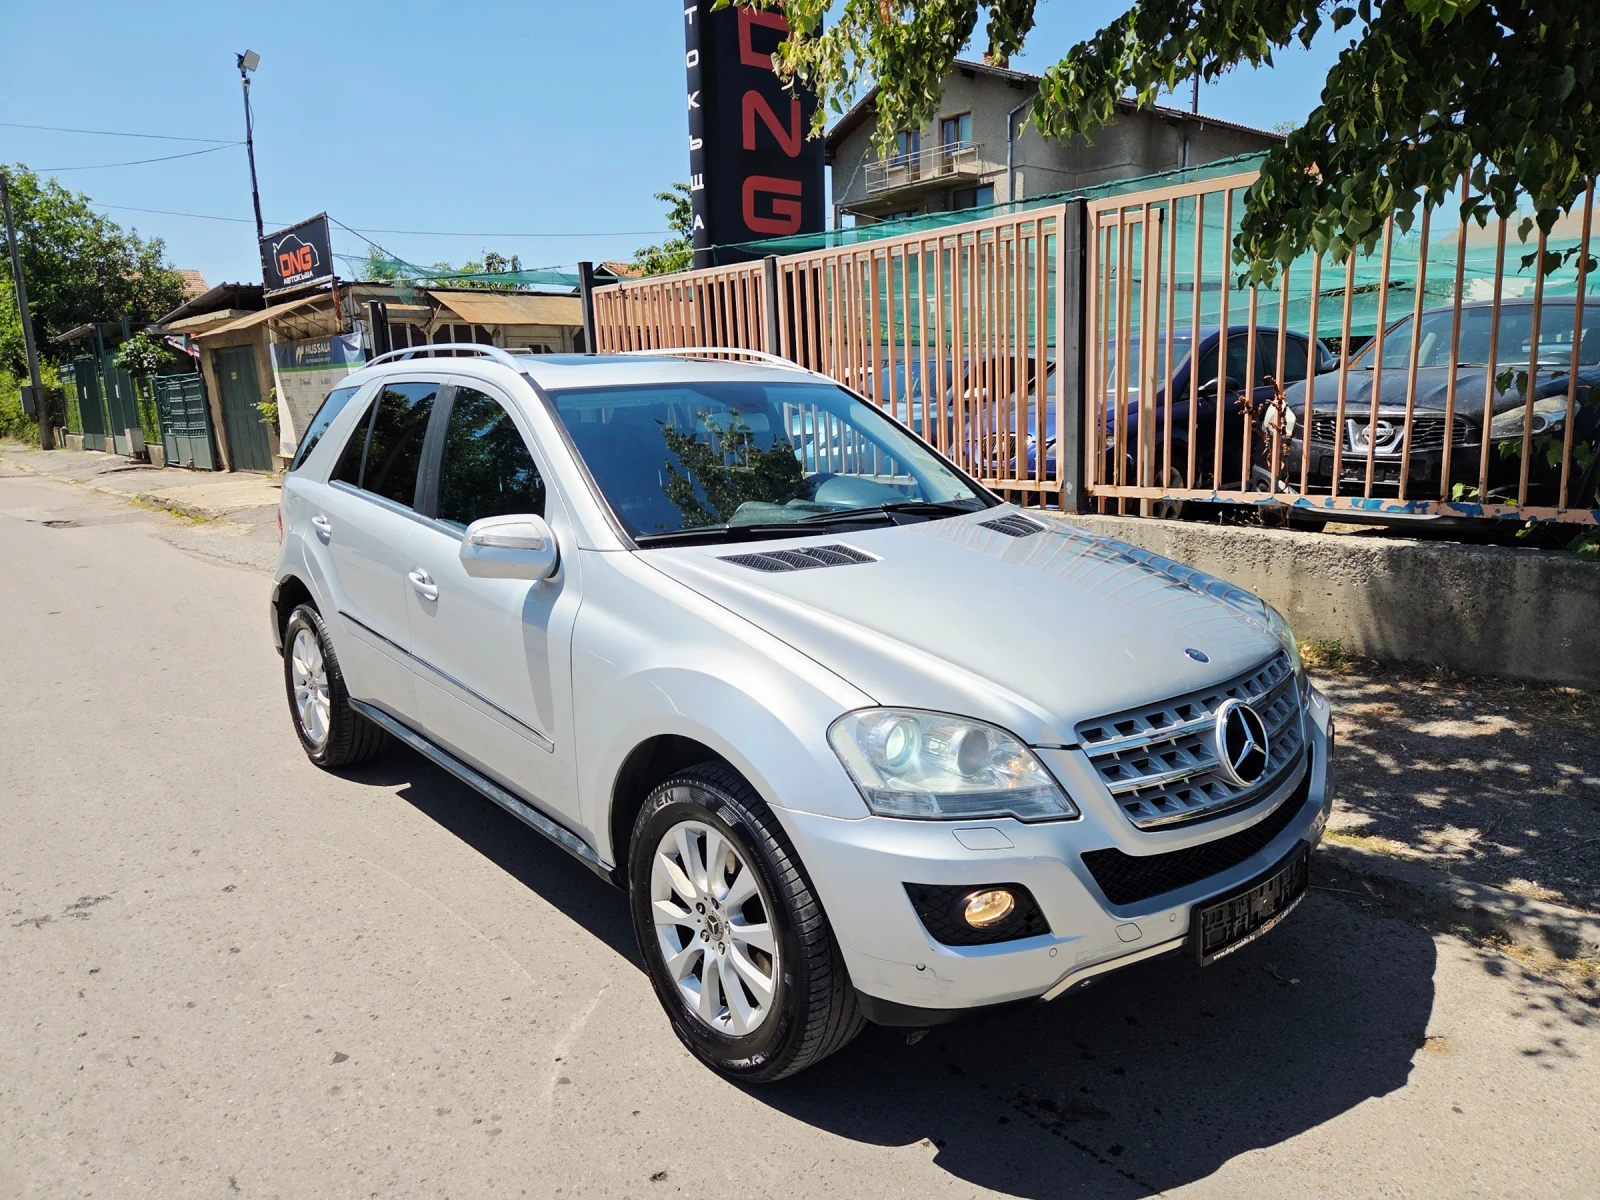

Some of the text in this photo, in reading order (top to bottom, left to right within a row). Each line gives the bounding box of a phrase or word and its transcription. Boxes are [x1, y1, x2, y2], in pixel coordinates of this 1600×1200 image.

[737, 4, 802, 236] DNG
[279, 245, 313, 278] DNG
[305, 342, 331, 355] MUSSALA
